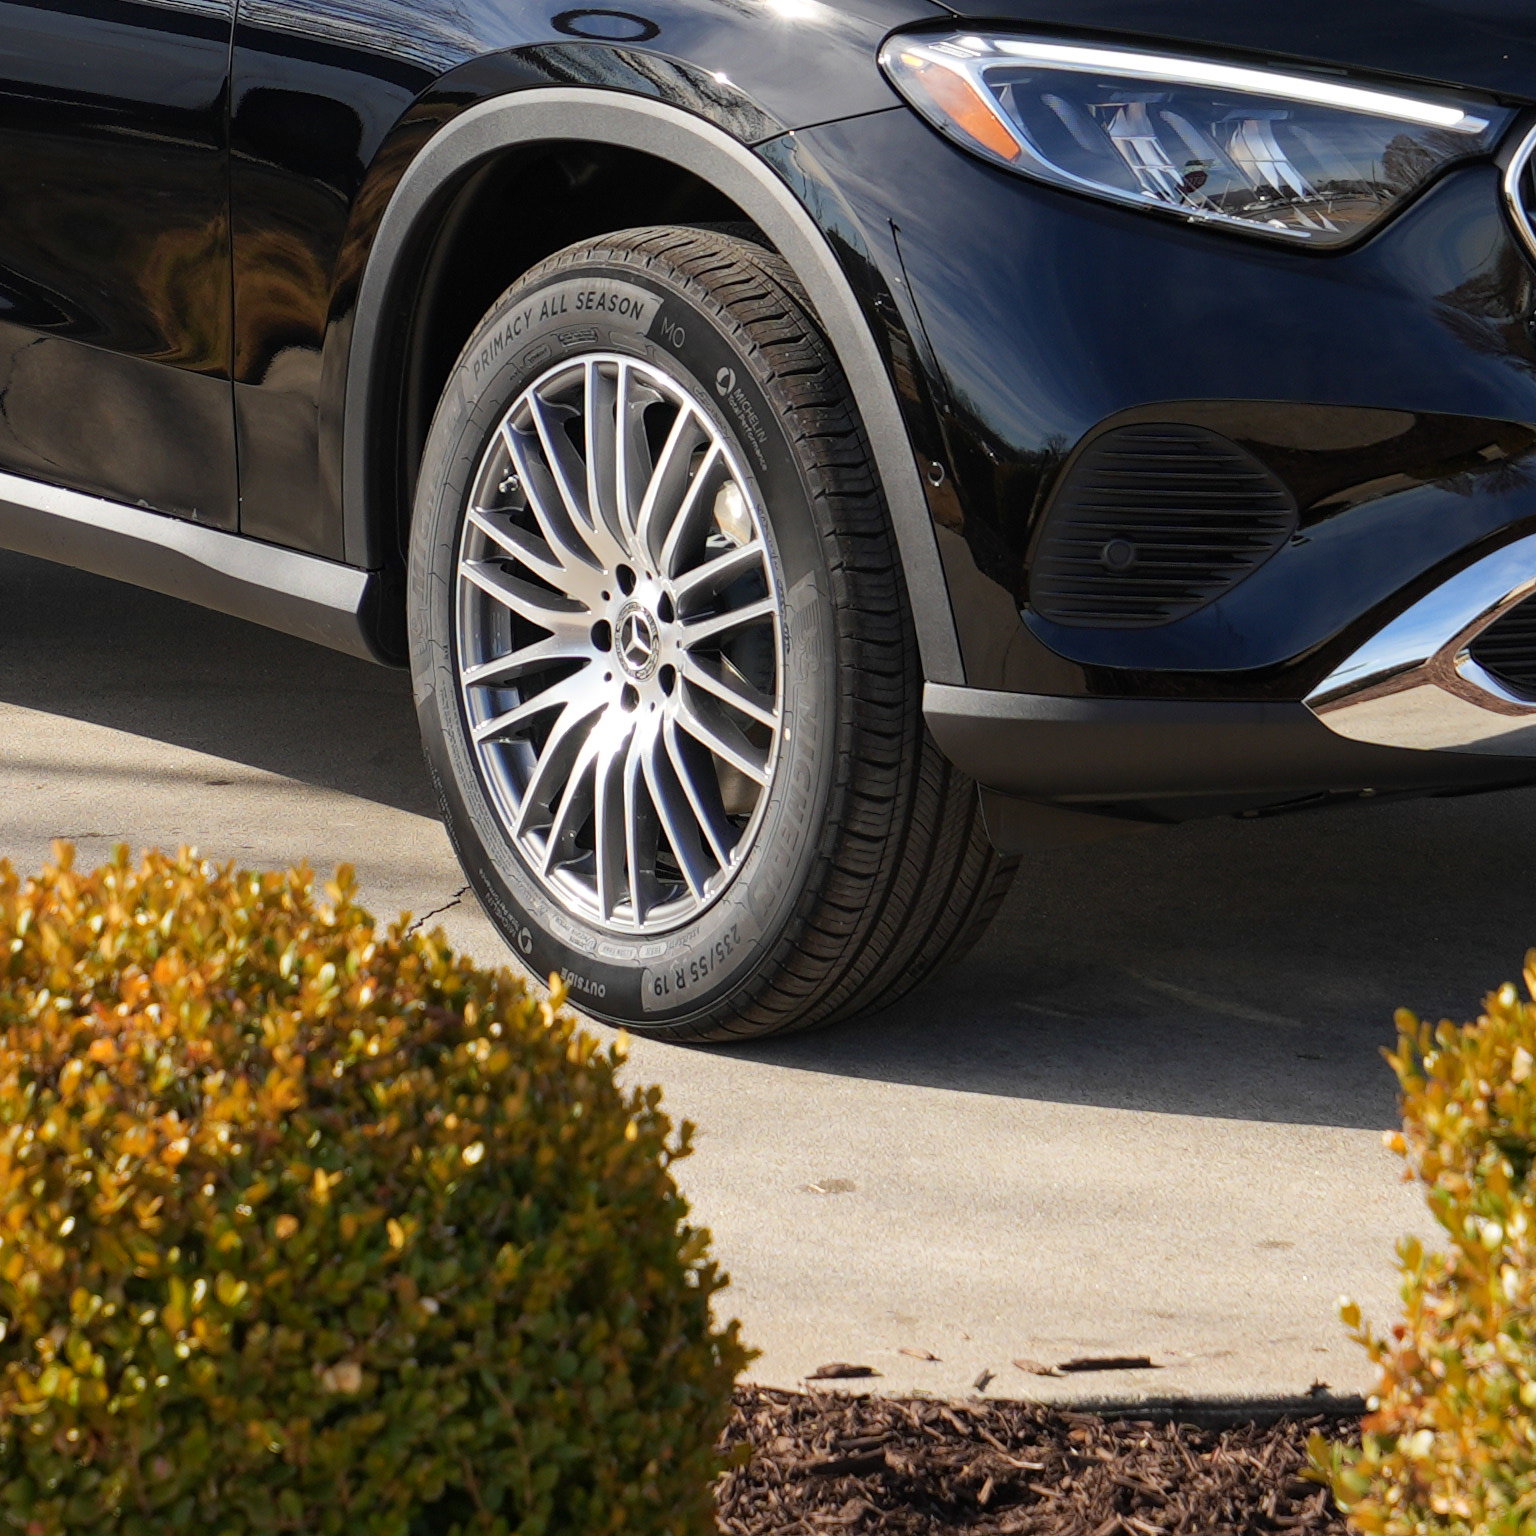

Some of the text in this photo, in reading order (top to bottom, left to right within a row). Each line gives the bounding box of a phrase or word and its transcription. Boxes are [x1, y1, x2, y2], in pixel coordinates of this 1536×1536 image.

[473, 308, 533, 381] PRIMACY
[539, 300, 568, 322] ALL
[575, 291, 645, 321] SEASON
[661, 316, 686, 348] MO
[733, 388, 768, 443] MICHELIN
[690, 923, 742, 983] 235/55
[560, 966, 606, 998] OUTSIDE
[653, 976, 670, 996] 19
[675, 974, 686, 989] R
